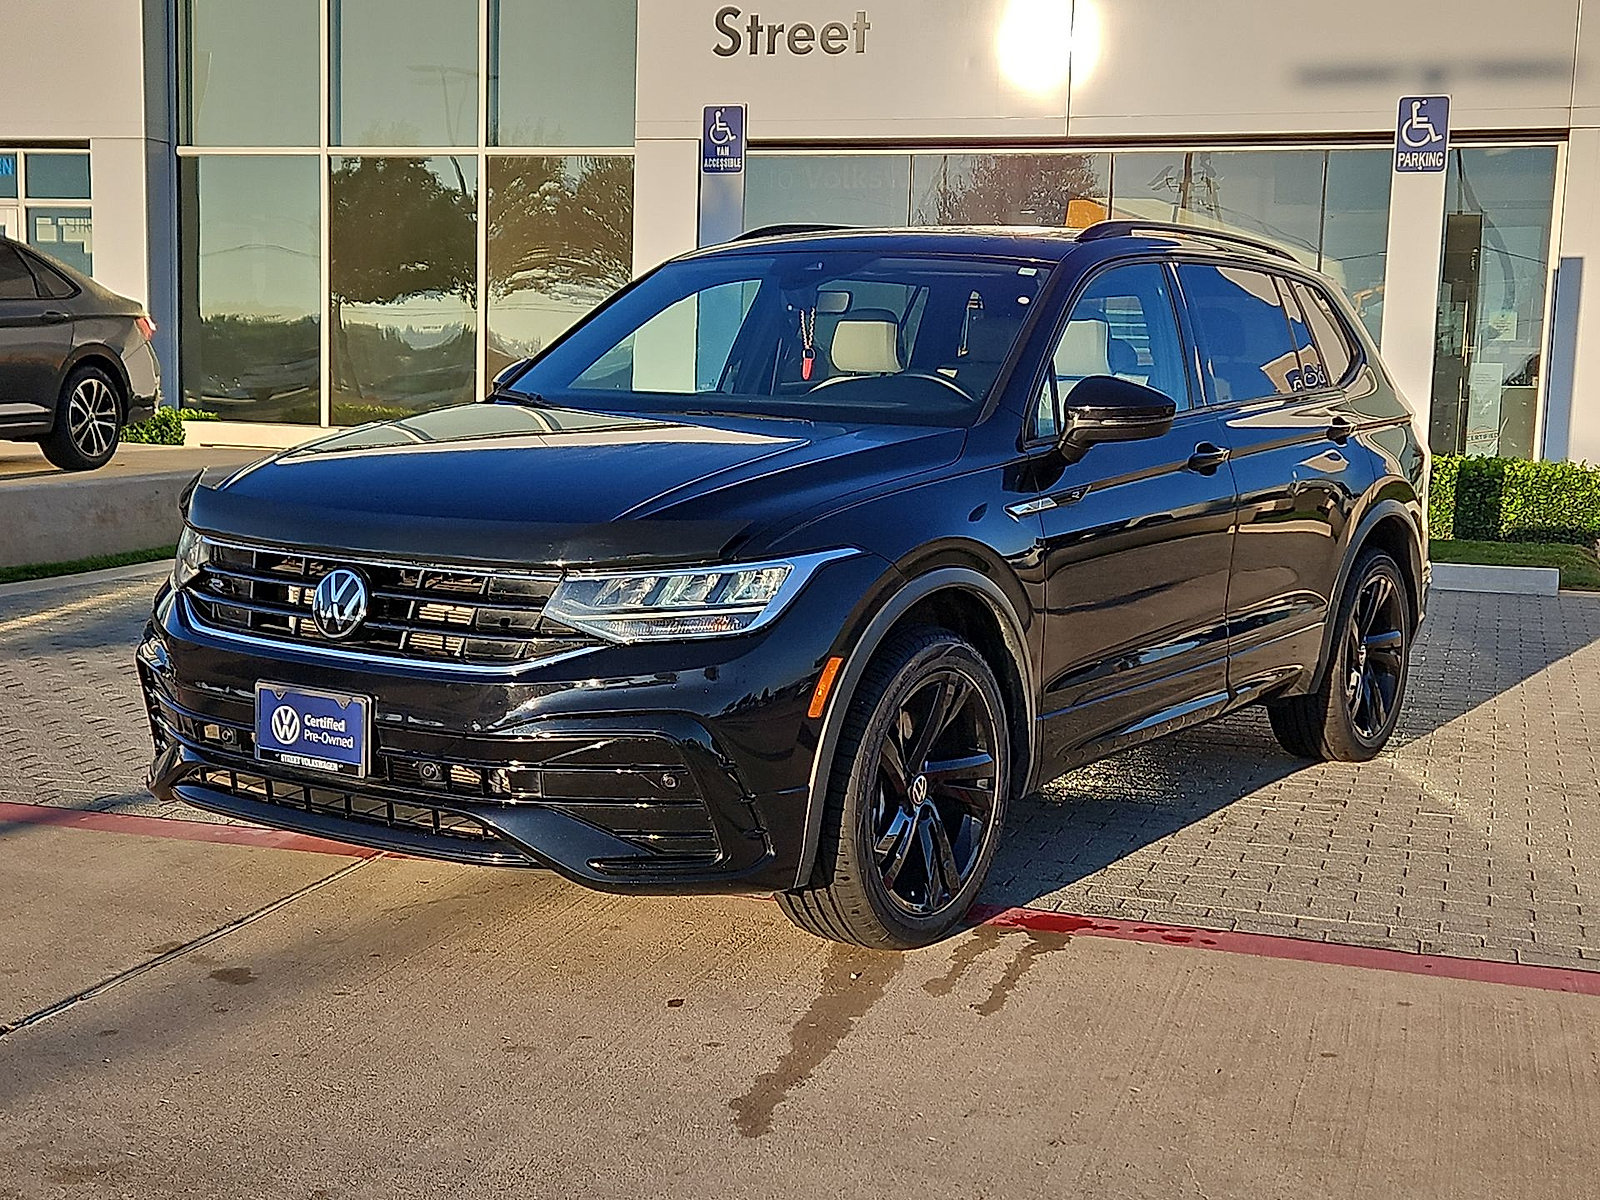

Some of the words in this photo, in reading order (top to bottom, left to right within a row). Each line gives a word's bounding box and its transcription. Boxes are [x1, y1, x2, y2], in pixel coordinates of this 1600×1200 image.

[712, 6, 871, 57] Street
[716, 146, 730, 156] VAN
[1397, 151, 1444, 168] PARKING
[703, 157, 742, 168] ACCESSIBLE
[303, 714, 346, 733] Certified
[303, 728, 354, 749] Pre-Owned
